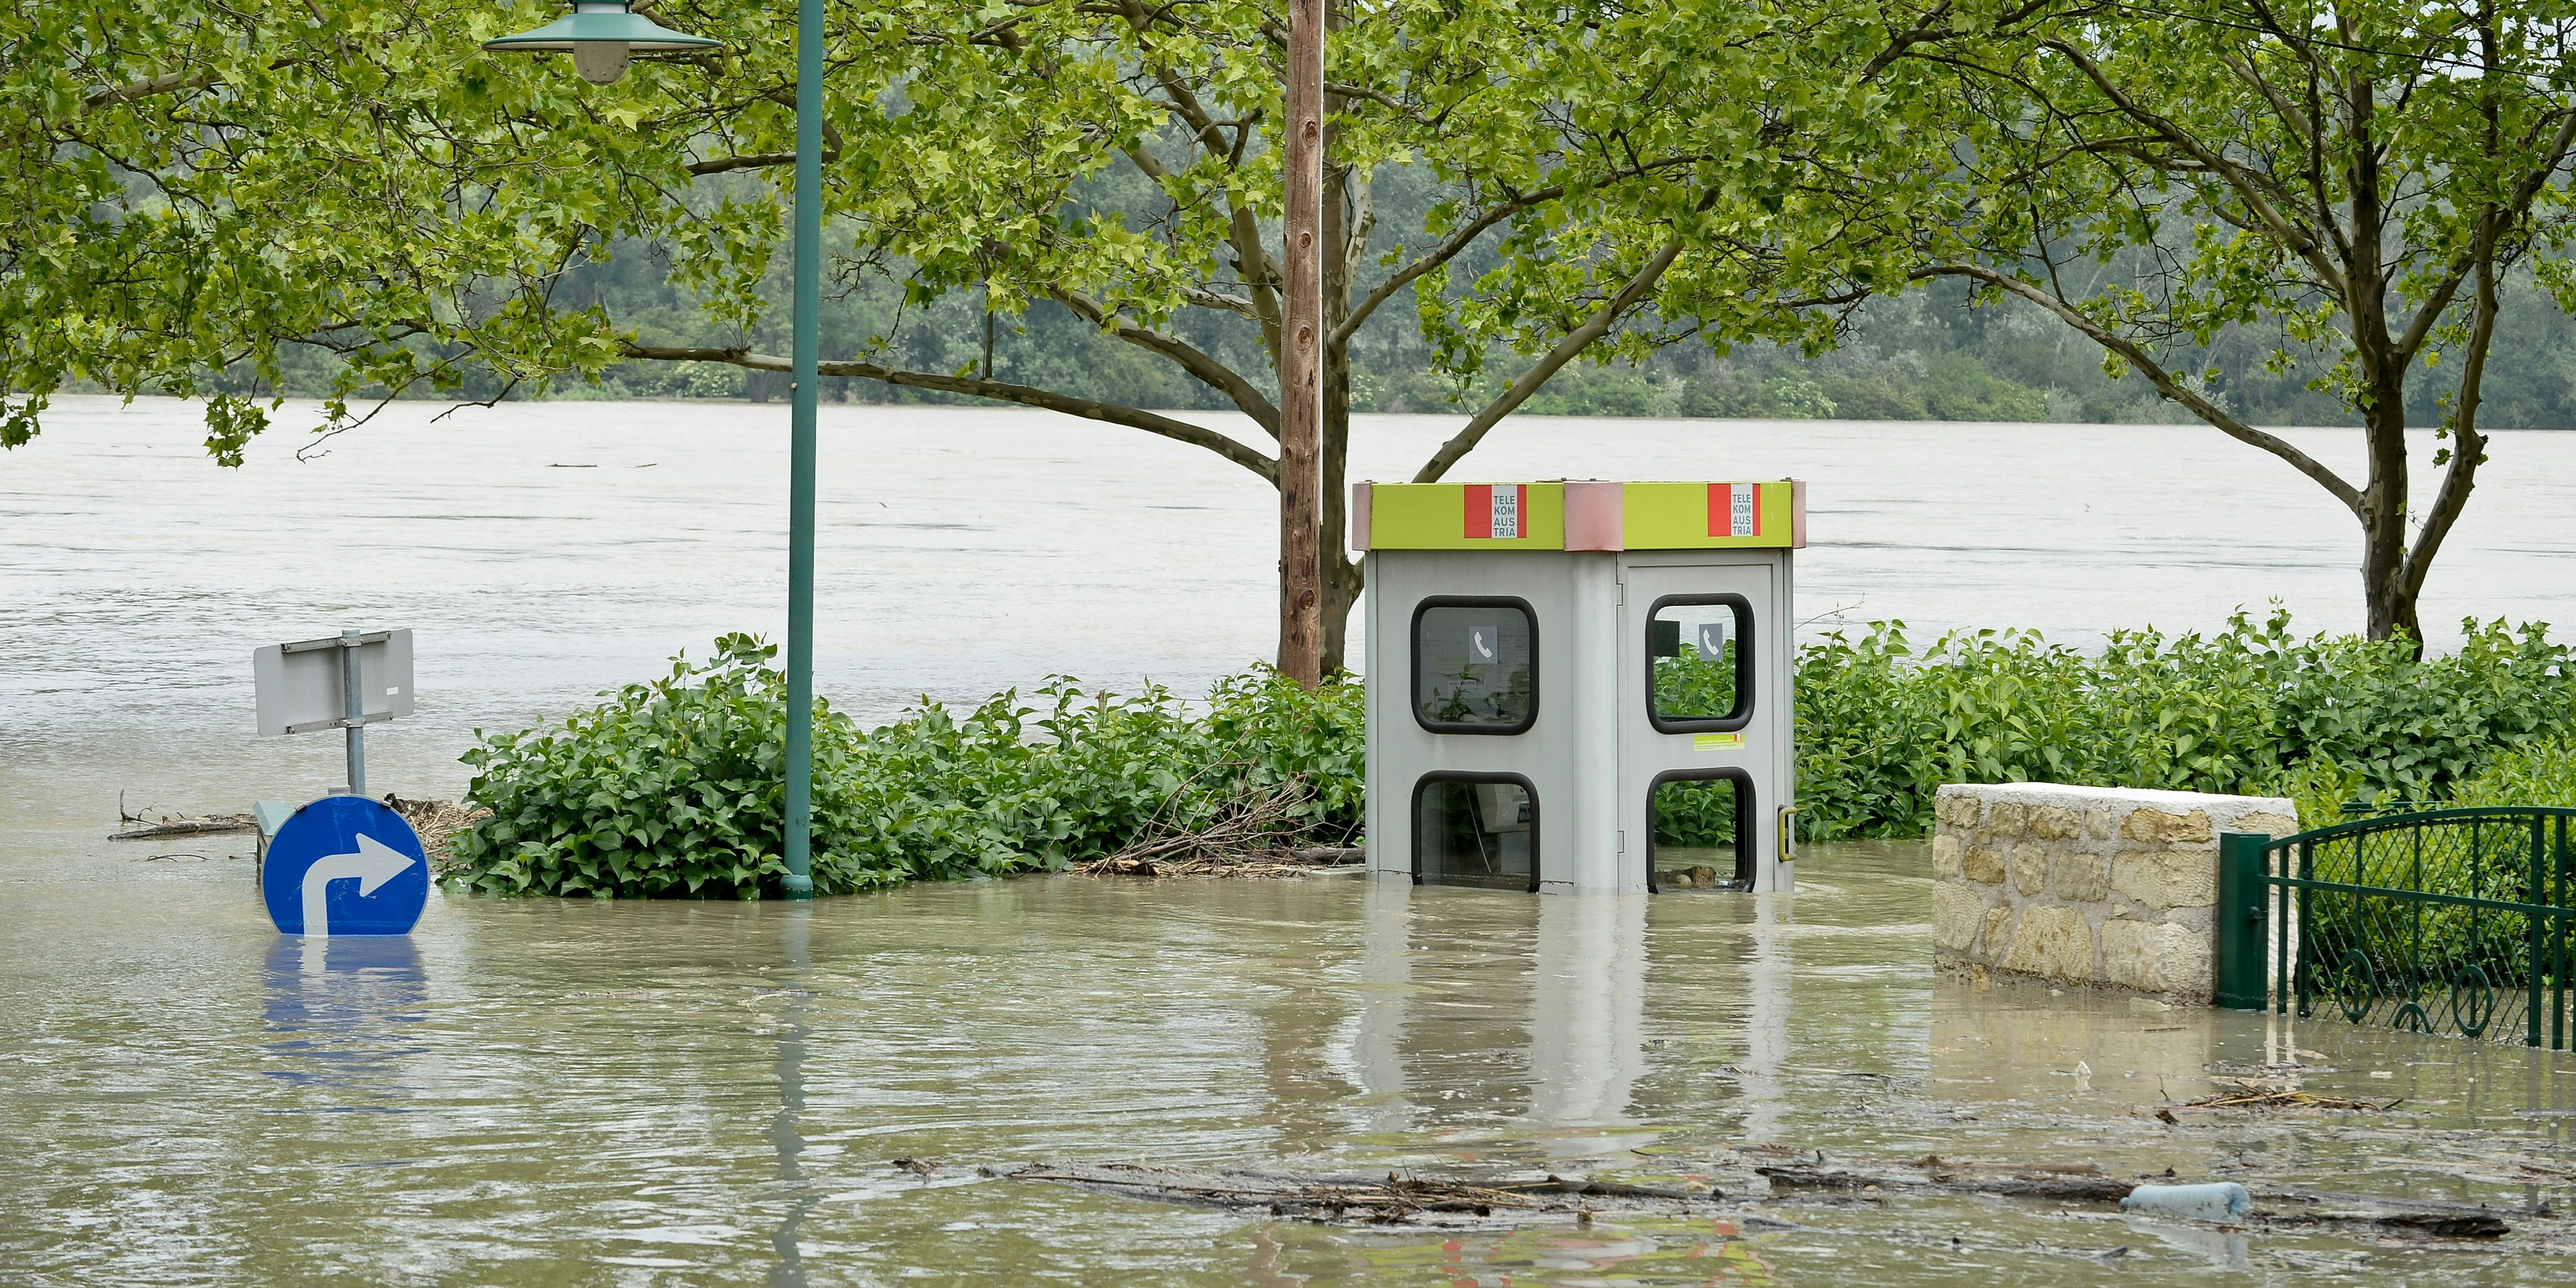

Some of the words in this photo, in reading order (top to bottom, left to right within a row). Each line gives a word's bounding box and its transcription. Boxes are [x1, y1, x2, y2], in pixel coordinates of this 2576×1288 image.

[1493, 495, 1515, 504] TELE
[1732, 494, 1750, 503] TELE
[1494, 506, 1515, 515] KOM
[1733, 504, 1750, 513] KOM
[1494, 517, 1515, 526] AUS
[1732, 516, 1751, 525] AUS
[1493, 527, 1515, 536] TRIA
[1732, 526, 1751, 535] TRIA
